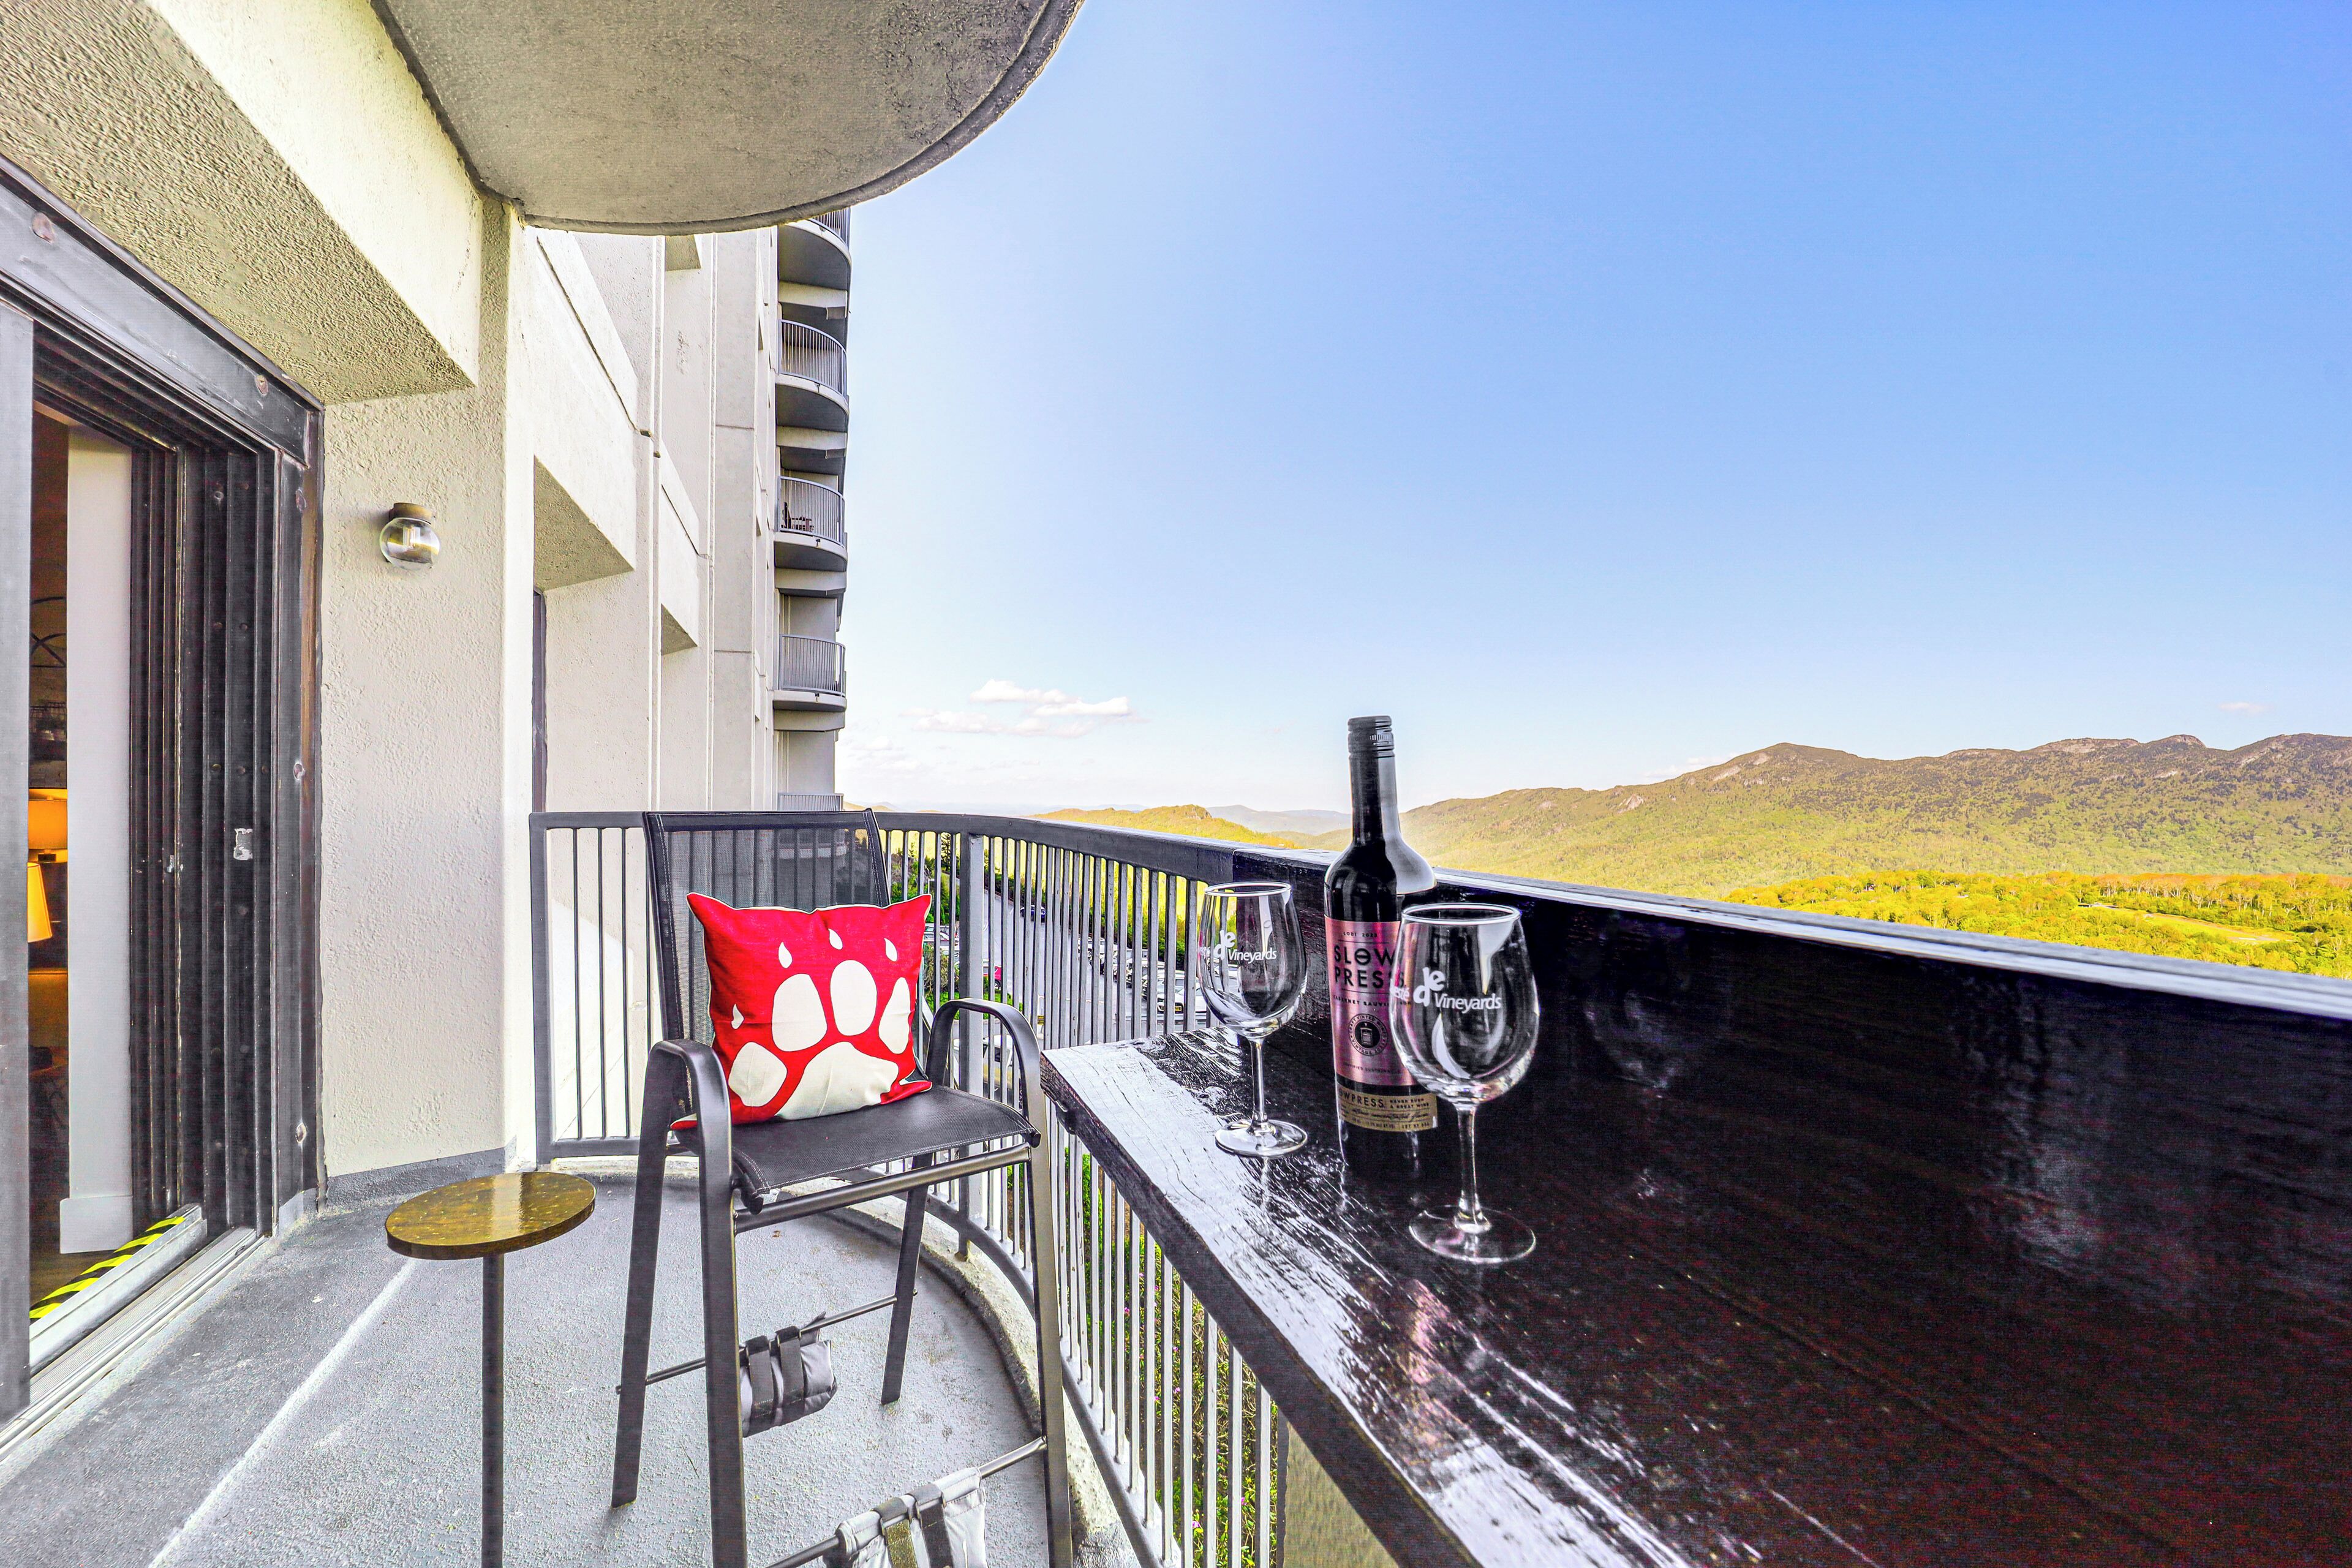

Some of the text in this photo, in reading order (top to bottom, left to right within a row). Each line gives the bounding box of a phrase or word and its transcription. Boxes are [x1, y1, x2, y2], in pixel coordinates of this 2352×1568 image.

[1228, 947, 1277, 964] Vineyards
[1334, 945, 1395, 966] SLOW
[1434, 992, 1502, 1014] Vineyards
